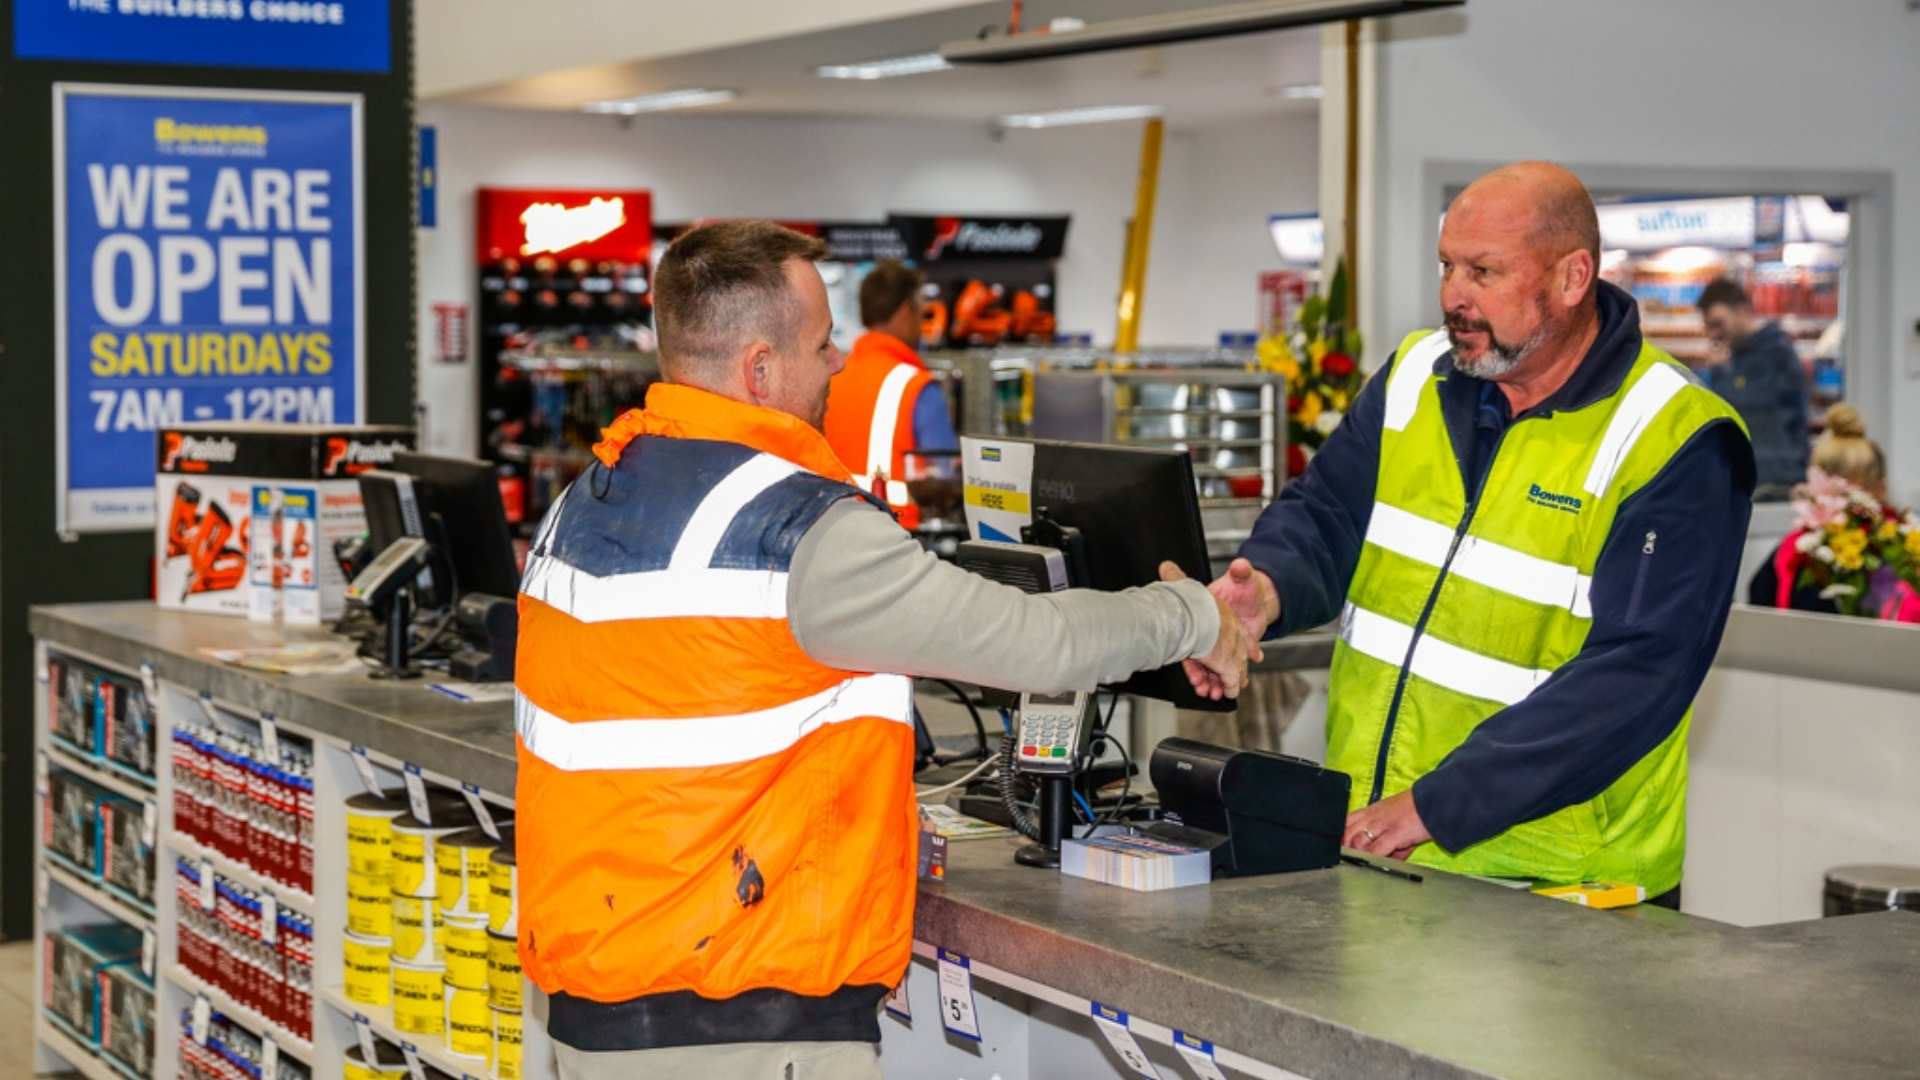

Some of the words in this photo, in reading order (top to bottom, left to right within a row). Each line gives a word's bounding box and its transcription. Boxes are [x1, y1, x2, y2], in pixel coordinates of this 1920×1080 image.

[117, 0, 245, 20] BUILDERS
[250, 0, 345, 25] CHOICE
[87, 163, 192, 230] WE
[205, 167, 332, 232] ARE
[91, 232, 332, 327] OPEN
[89, 332, 334, 377] SATURDAYS
[89, 388, 184, 432] 7AM
[224, 387, 335, 424] 12PM
[1529, 483, 1582, 509] Bowens
